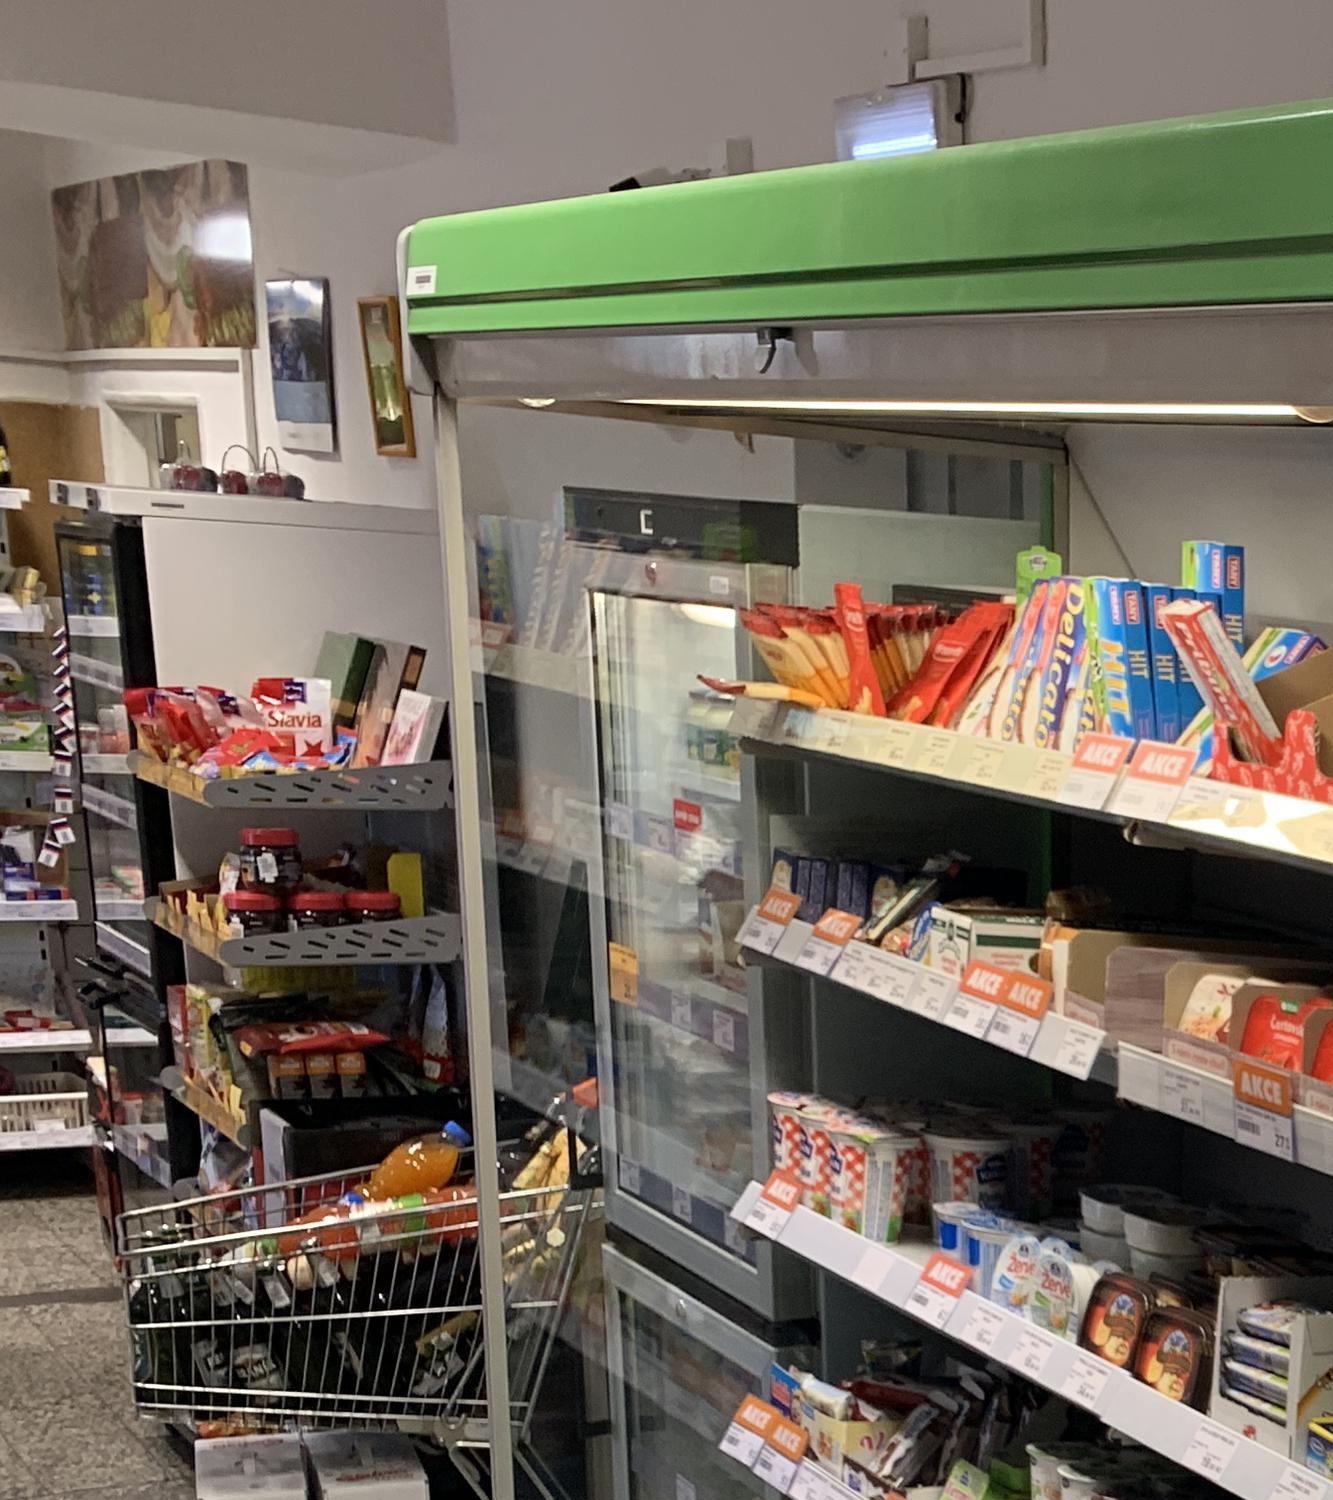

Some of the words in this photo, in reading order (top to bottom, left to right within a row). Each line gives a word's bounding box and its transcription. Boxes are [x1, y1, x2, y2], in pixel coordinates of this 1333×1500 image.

[1034, 583, 1085, 748] Delicato
[1128, 650, 1149, 679] HIT
[1155, 655, 1176, 684] HIT
[1240, 1071, 1283, 1106] AKCE
[926, 1261, 966, 1289] AKCE
